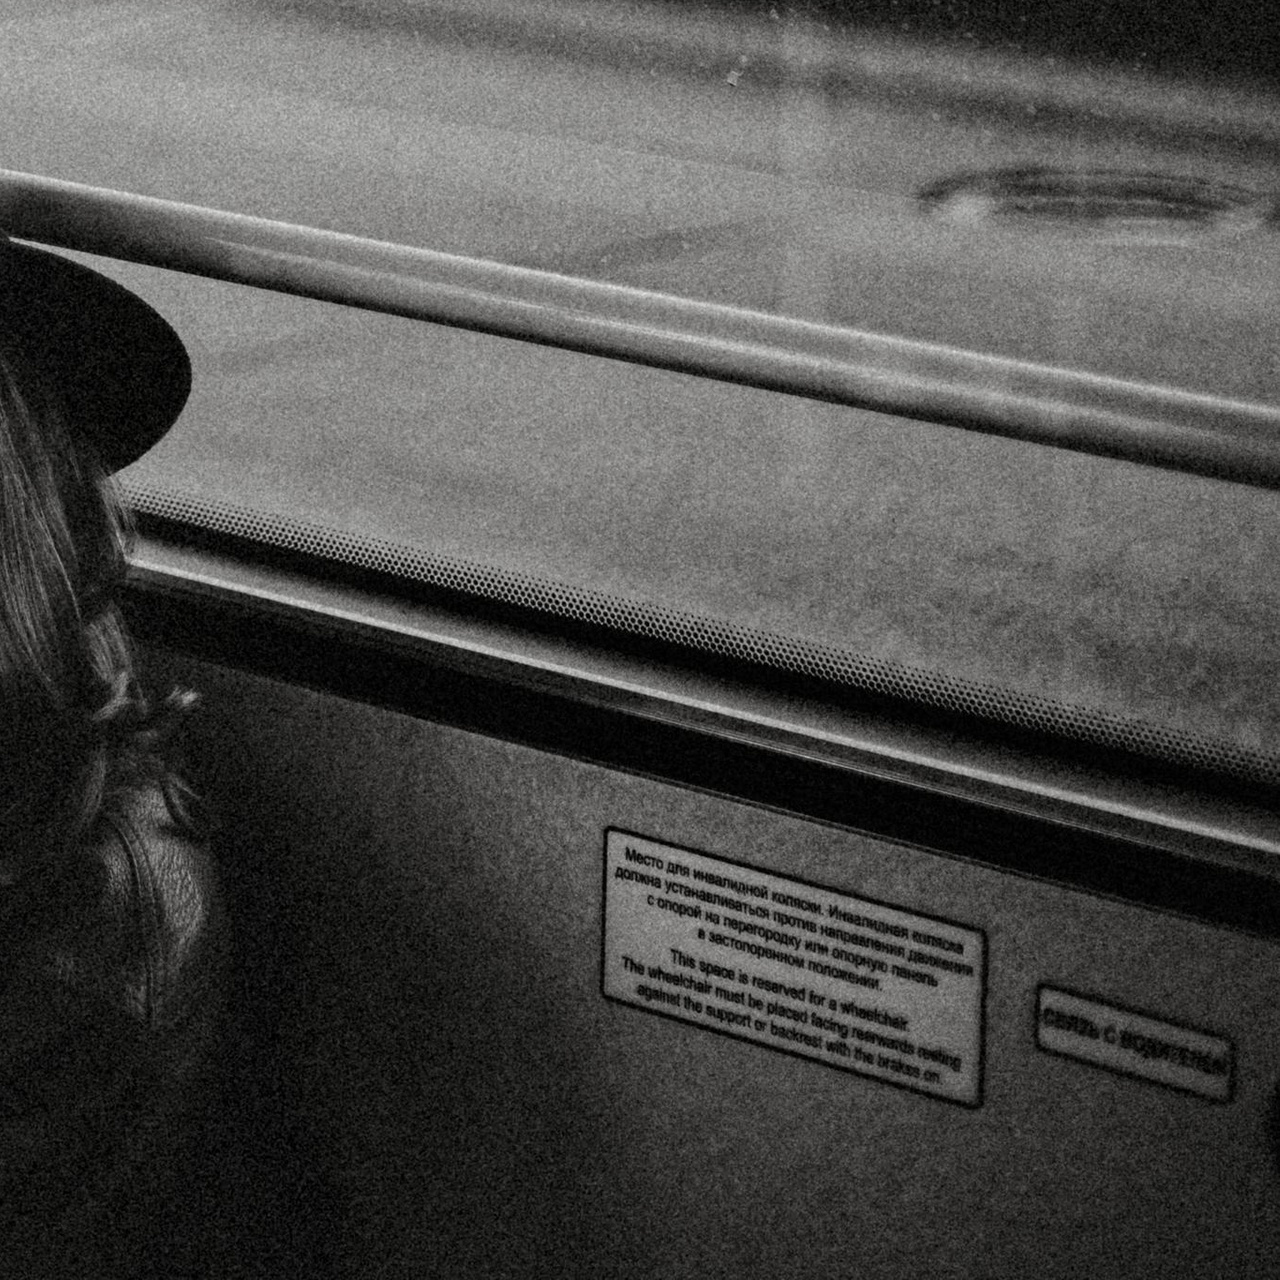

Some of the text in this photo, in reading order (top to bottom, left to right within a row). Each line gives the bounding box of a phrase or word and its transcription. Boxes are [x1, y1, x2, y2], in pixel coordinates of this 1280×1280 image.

[614, 866, 661, 888] должна
[665, 881, 769, 917] устанавливаться
[773, 911, 816, 932] против
[625, 847, 663, 869] Место
[666, 862, 689, 875] для
[693, 869, 767, 898] инвалидной
[771, 892, 825, 915] коляски.
[646, 893, 937, 987] с опорой на перегородку или опорную панель
[696, 927, 706, 940] в
[709, 931, 804, 967] застопоренном
[621, 955, 644, 975] The
[647, 966, 712, 993] wheelchair
[715, 986, 744, 1004] must
[748, 993, 763, 1010] be
[766, 1002, 807, 1023] placed
[811, 1012, 848, 1038] facing
[670, 948, 695, 968] This
[699, 960, 734, 980] space
[737, 969, 749, 985] is
[751, 976, 805, 1000] reserved
[808, 990, 825, 1005] for
[827, 998, 837, 1011] a
[636, 984, 680, 1006] against
[683, 996, 702, 1013] the
[706, 1005, 750, 1026] support
[754, 1019, 766, 1030] or
[770, 1022, 821, 1047] backrest
[826, 1039, 850, 1056] with
[854, 1047, 873, 1064] the
[877, 1055, 919, 1077] brakes
